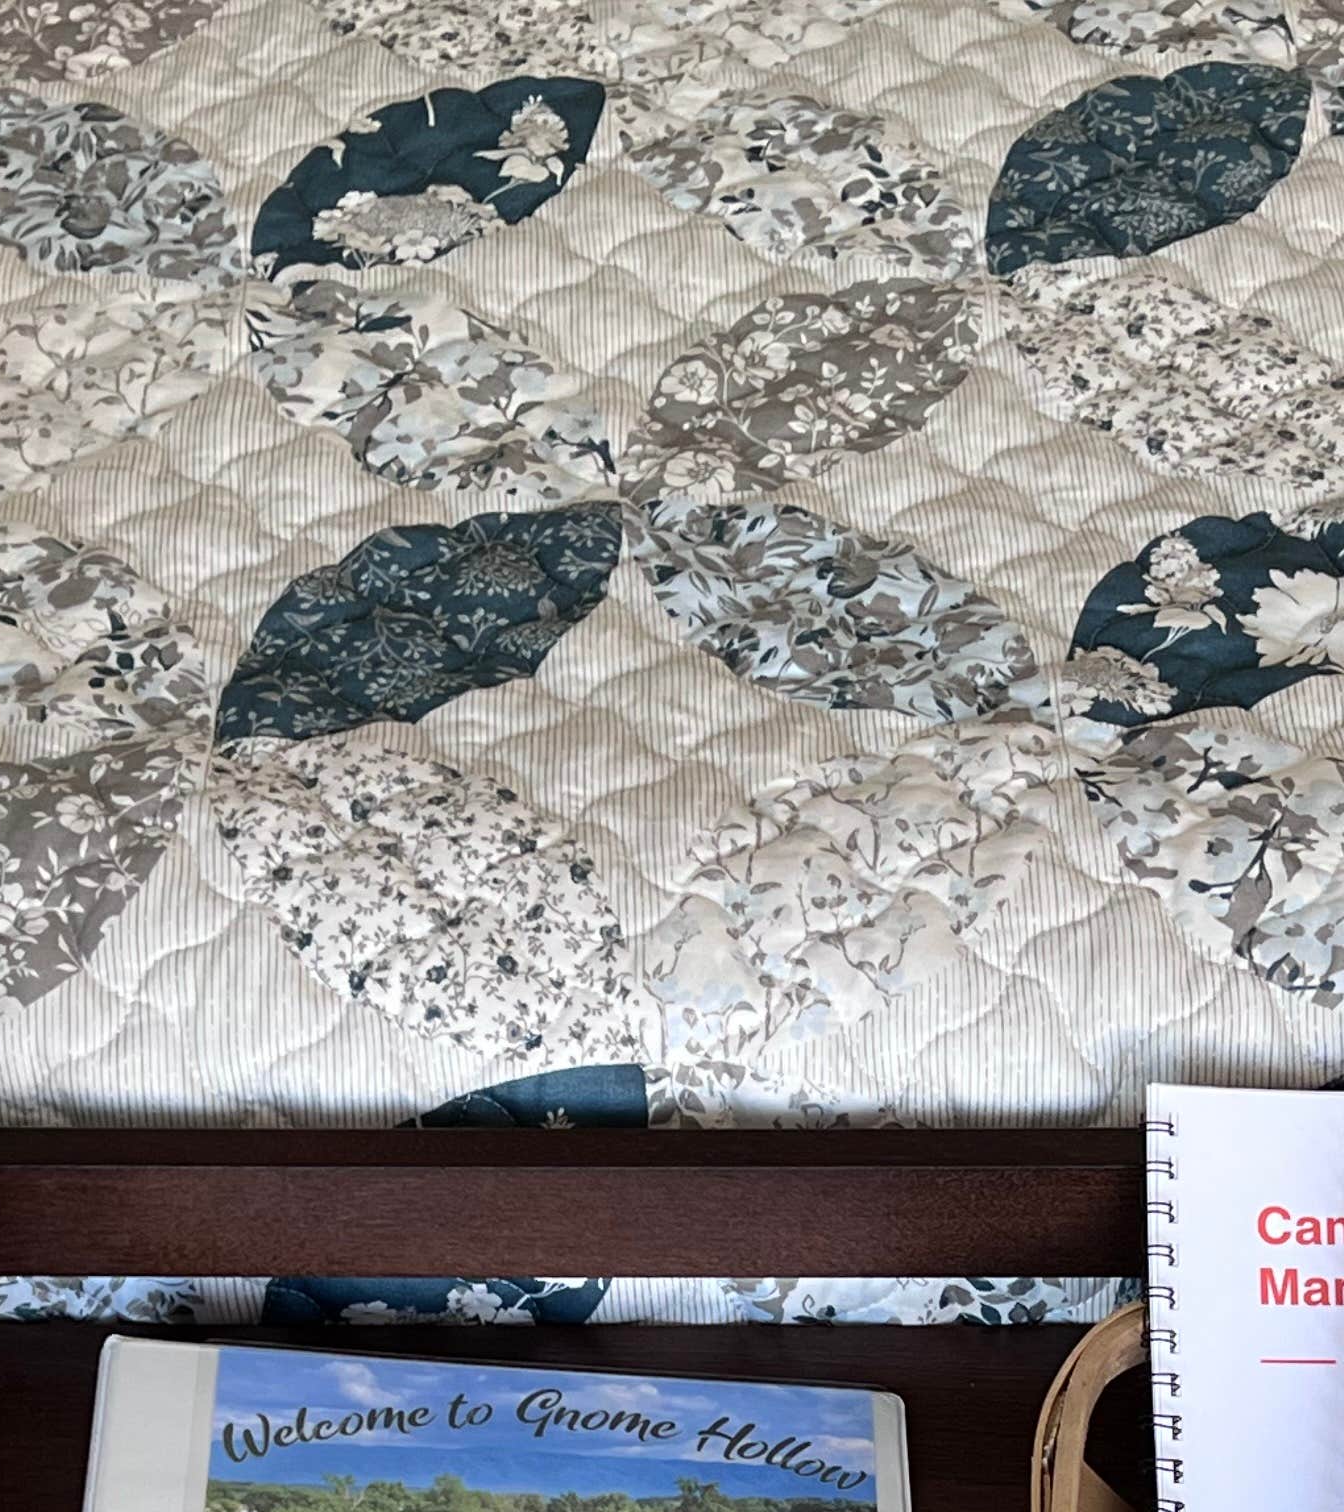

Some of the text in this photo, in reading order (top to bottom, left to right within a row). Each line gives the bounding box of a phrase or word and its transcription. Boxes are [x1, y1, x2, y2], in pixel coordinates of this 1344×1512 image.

[221, 1387, 869, 1491] Welcome to Gnome Hollow
